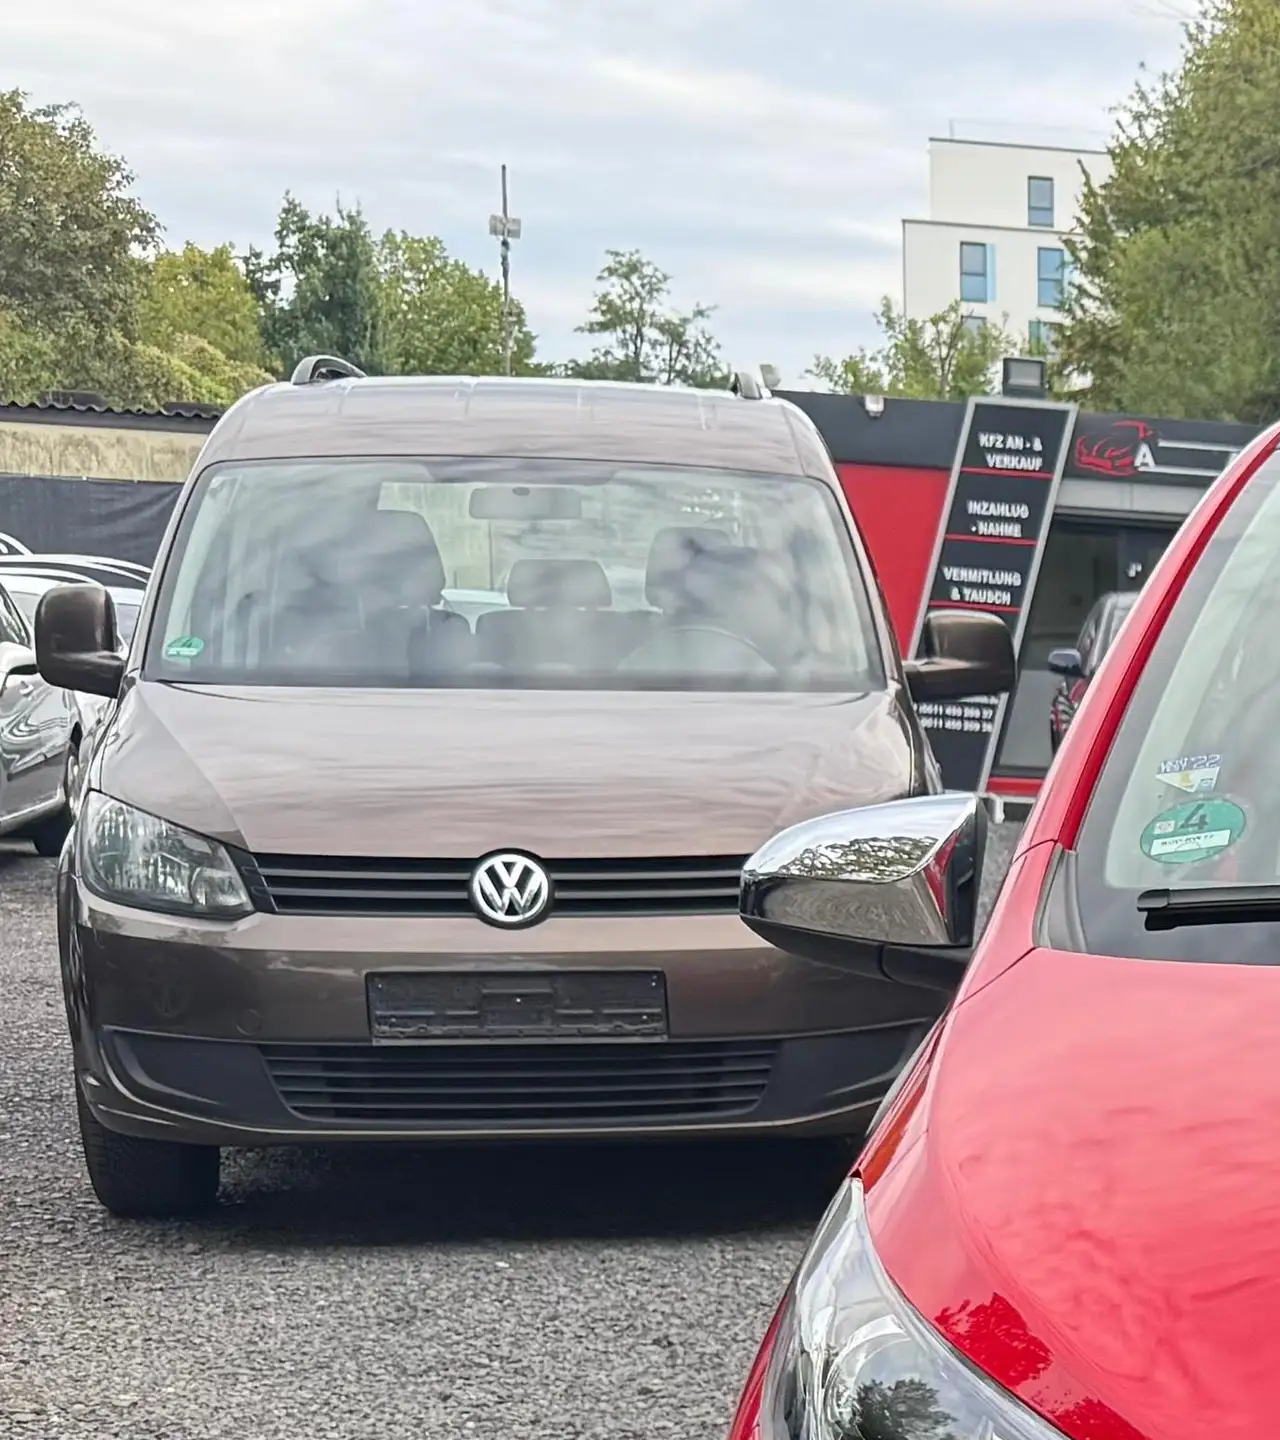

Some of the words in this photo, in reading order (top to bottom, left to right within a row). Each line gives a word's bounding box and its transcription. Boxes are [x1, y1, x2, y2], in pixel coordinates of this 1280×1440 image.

[979, 433, 1004, 448] KFZ
[985, 453, 1043, 471] VERKAUF
[963, 588, 1011, 606] TAUSCH
